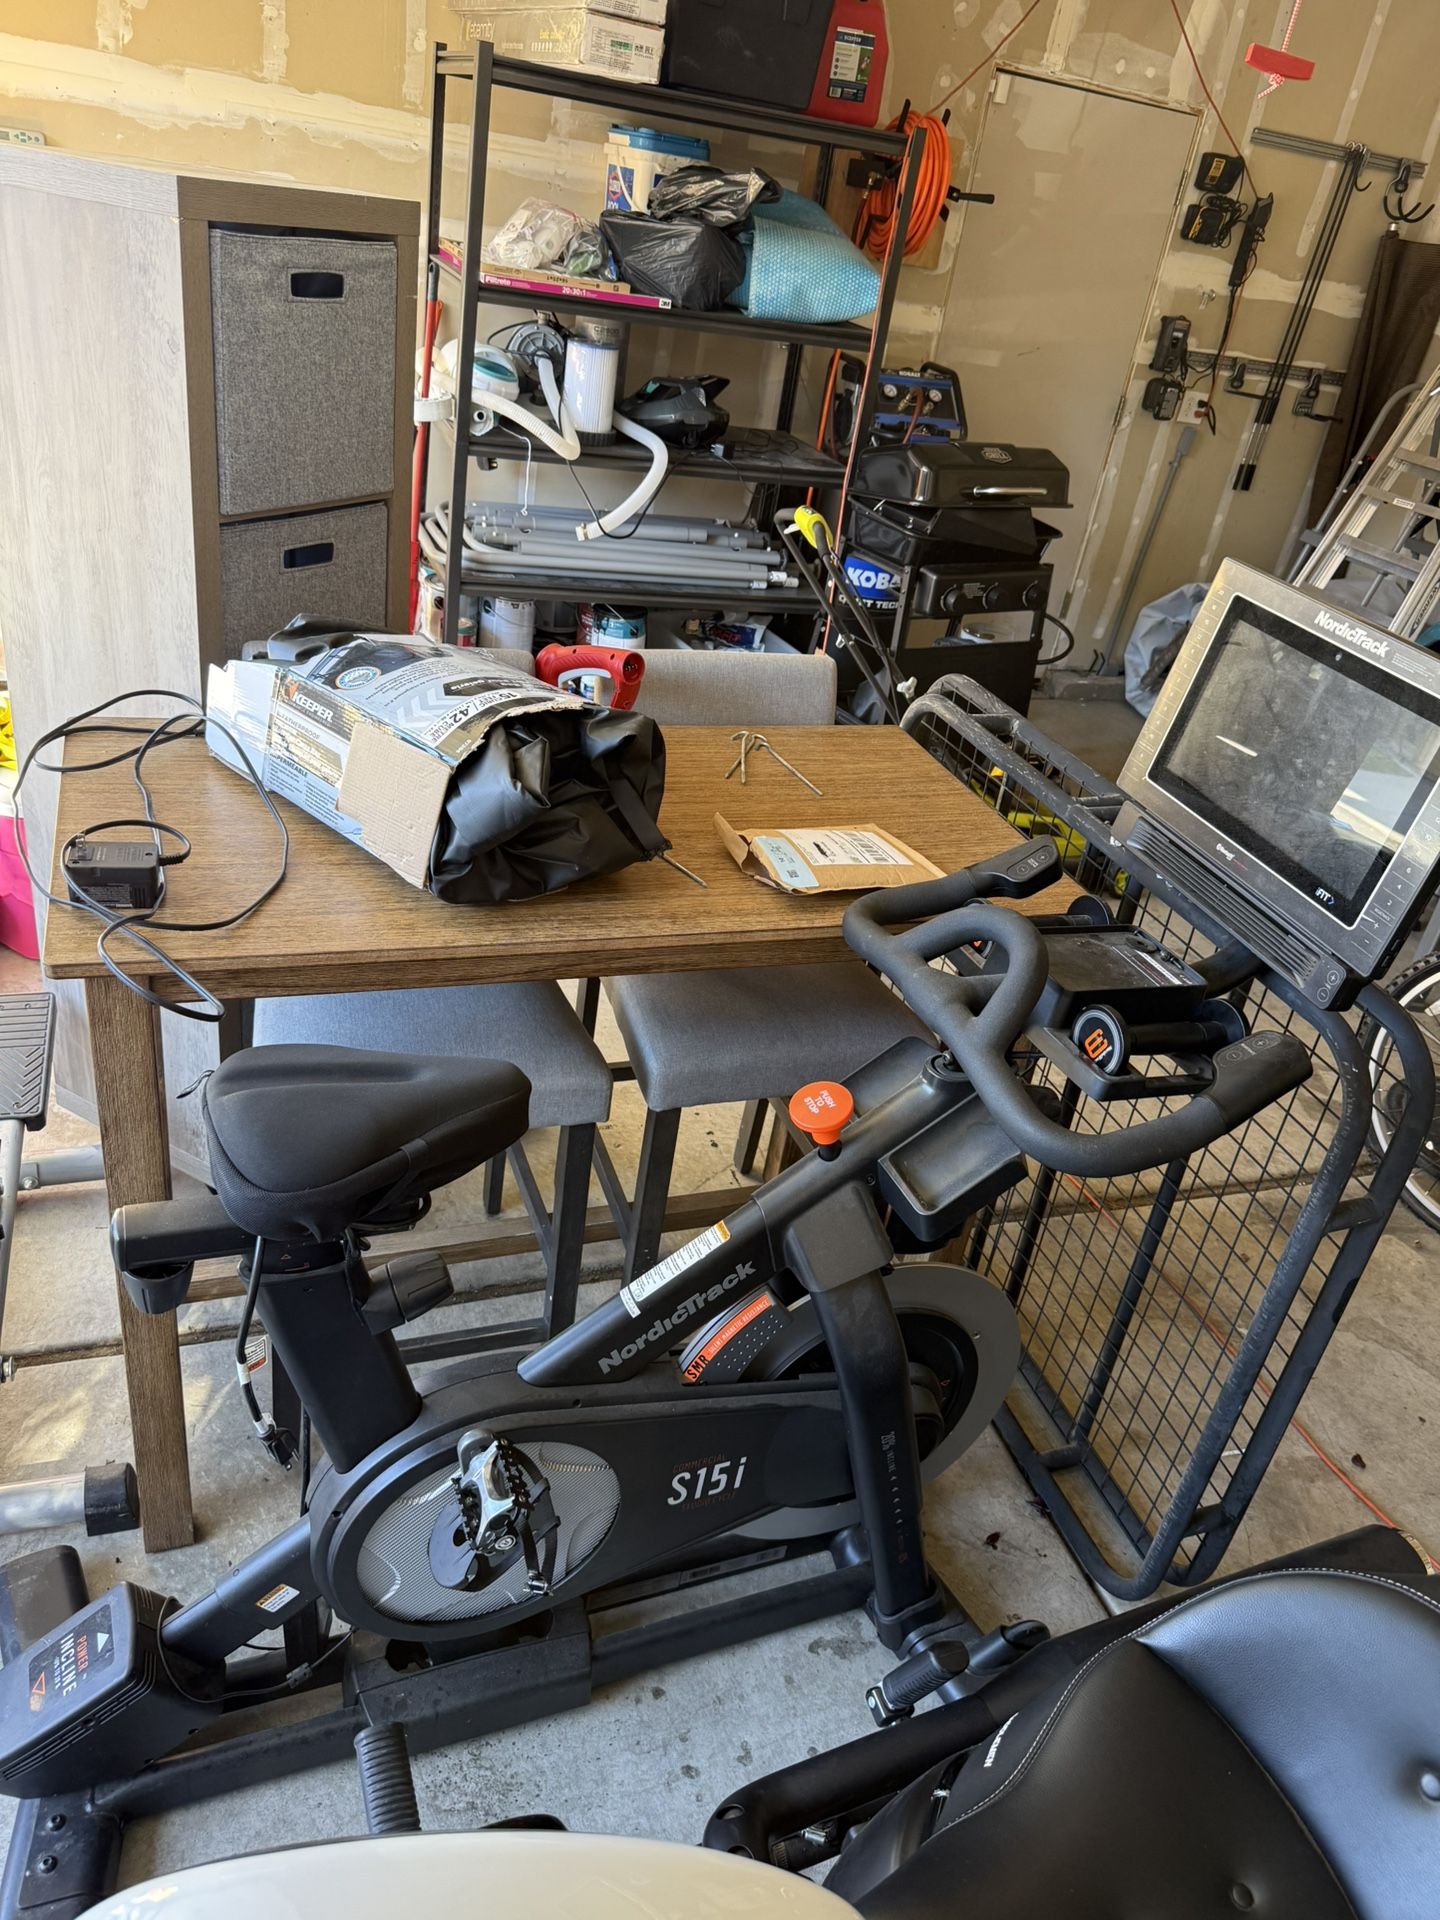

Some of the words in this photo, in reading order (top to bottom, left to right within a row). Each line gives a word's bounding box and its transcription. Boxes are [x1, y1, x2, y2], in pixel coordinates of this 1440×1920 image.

[848, 567, 901, 590] KOBA
[1314, 610, 1391, 658] NordicTrack
[291, 691, 334, 723] KEEPER
[804, 1097, 820, 1114] STOP
[815, 1096, 825, 1107] TO
[820, 1090, 837, 1108] PUSH
[598, 1261, 756, 1375] NordicTrack
[687, 1355, 710, 1379] SMR
[667, 1456, 747, 1506] S15i
[60, 1632, 77, 1697] INCLINE
[76, 1634, 89, 1673] POWER
